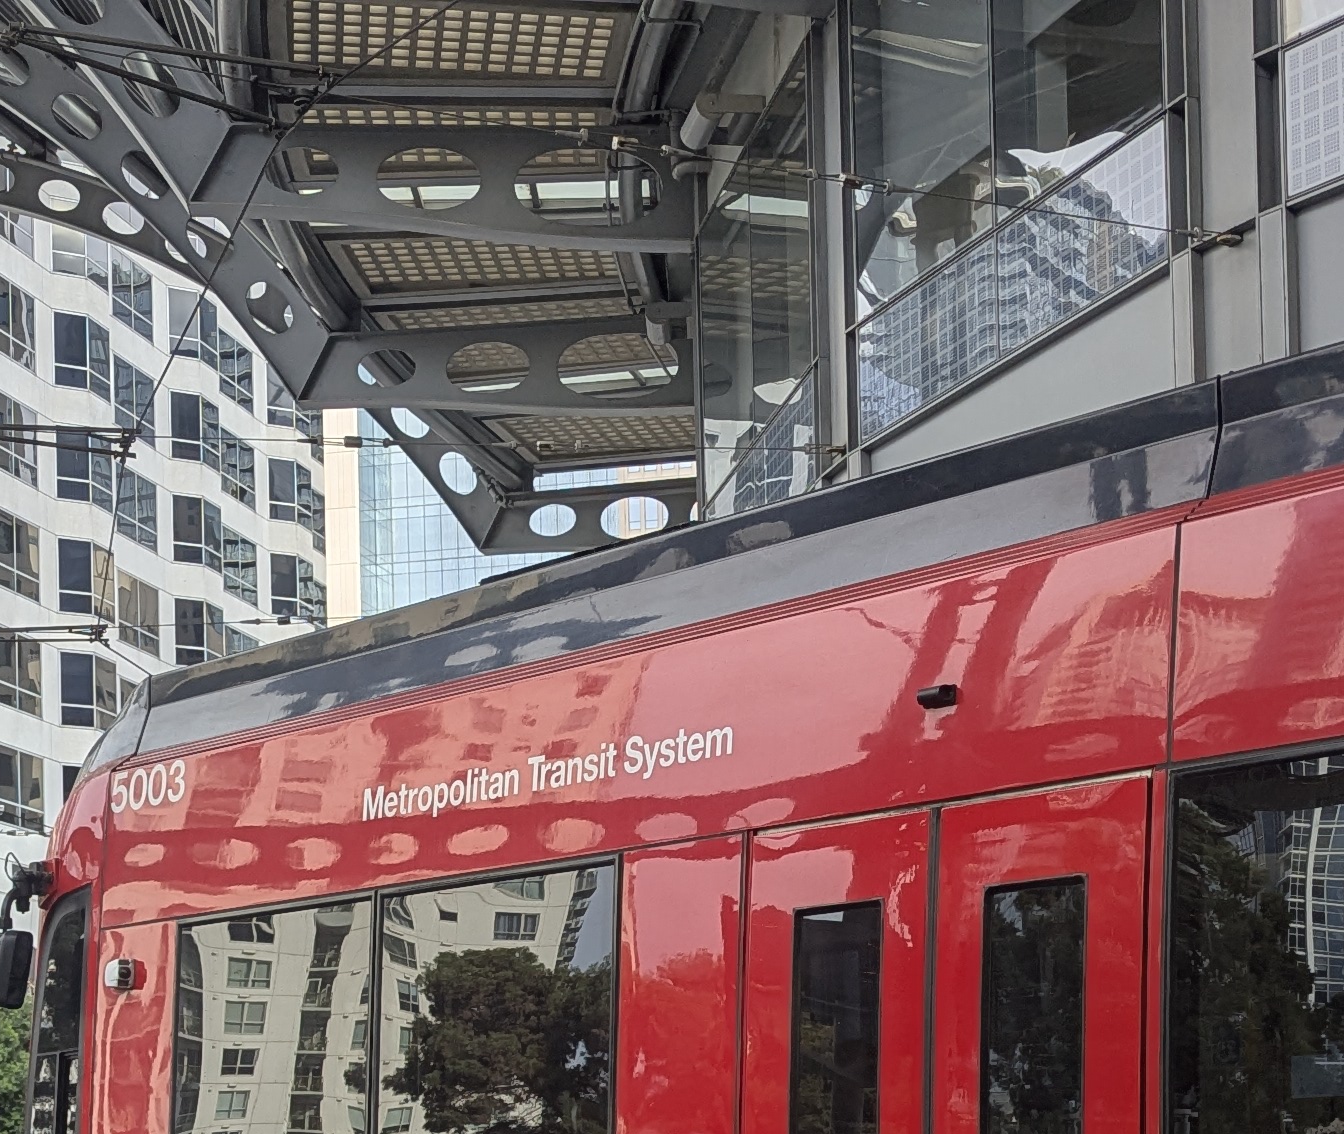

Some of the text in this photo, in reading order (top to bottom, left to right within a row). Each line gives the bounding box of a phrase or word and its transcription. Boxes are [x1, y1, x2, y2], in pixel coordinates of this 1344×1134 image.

[111, 759, 185, 813] 5003
[362, 726, 734, 821] Metropolitan Transit System
